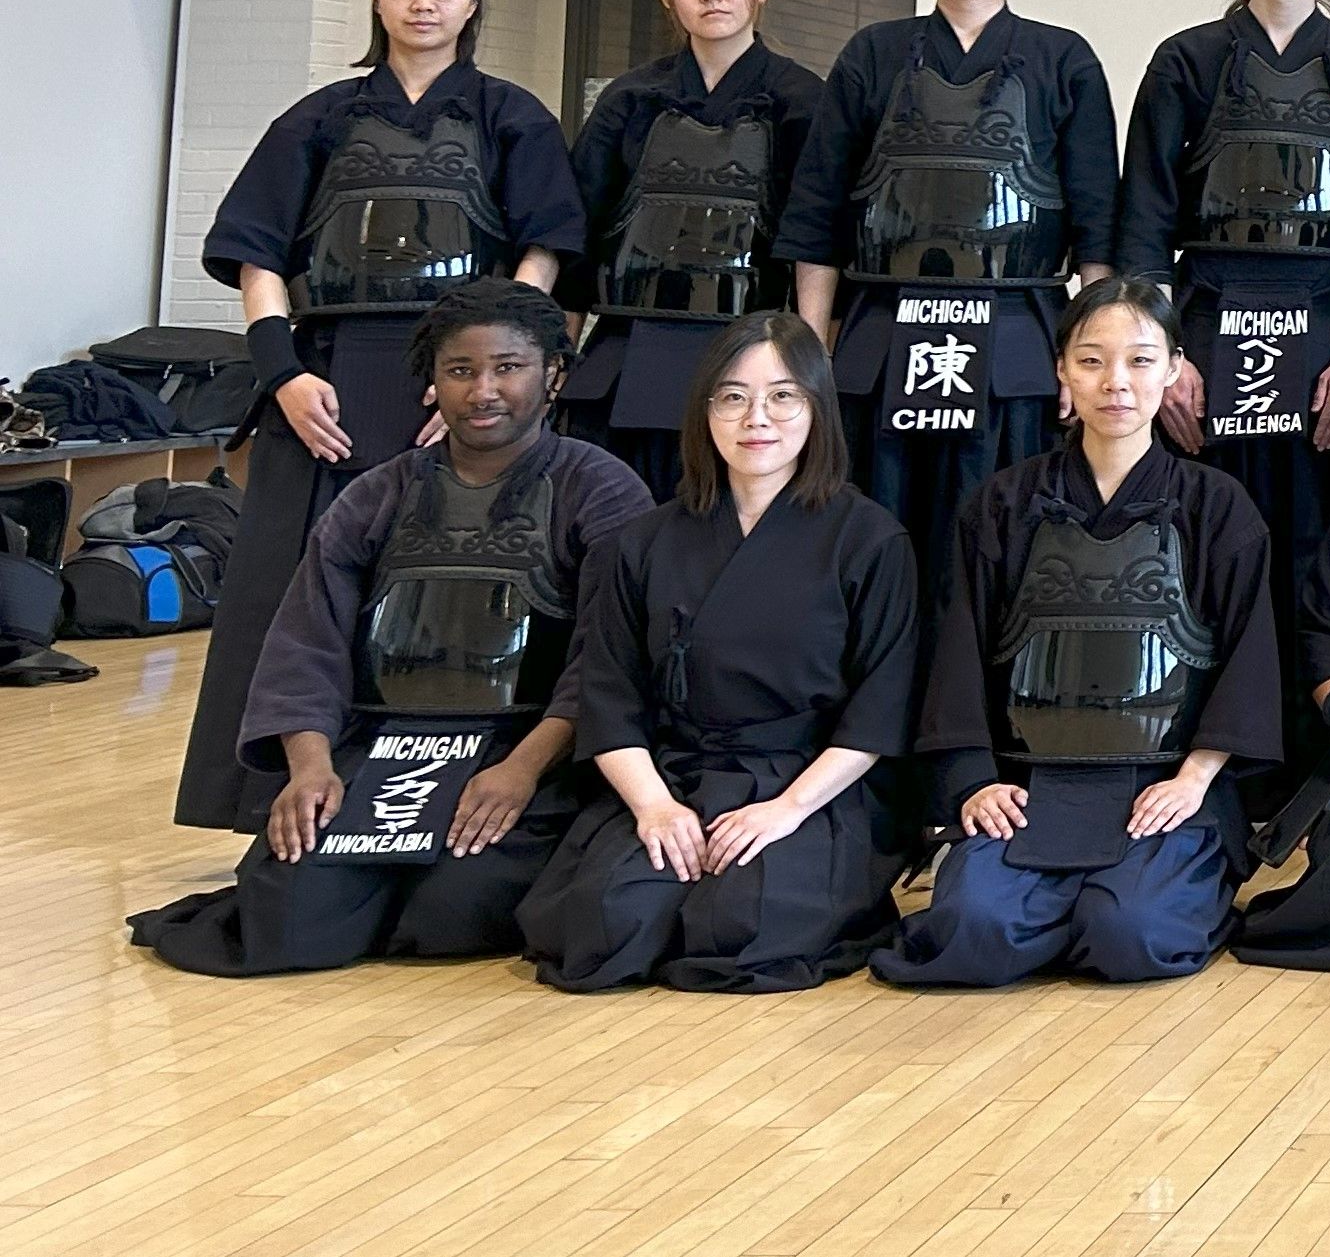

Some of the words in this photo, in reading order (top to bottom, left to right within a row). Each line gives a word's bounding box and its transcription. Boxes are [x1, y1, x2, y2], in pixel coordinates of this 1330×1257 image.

[896, 299, 990, 324] MICHIGAN
[1219, 310, 1308, 336] MICHIGAN
[904, 333, 977, 397] 陳
[891, 408, 976, 430] CHIN
[1212, 413, 1303, 436] VELLENGA
[369, 734, 482, 760] MICHIGAN
[319, 832, 434, 854] NWOKEABIA
